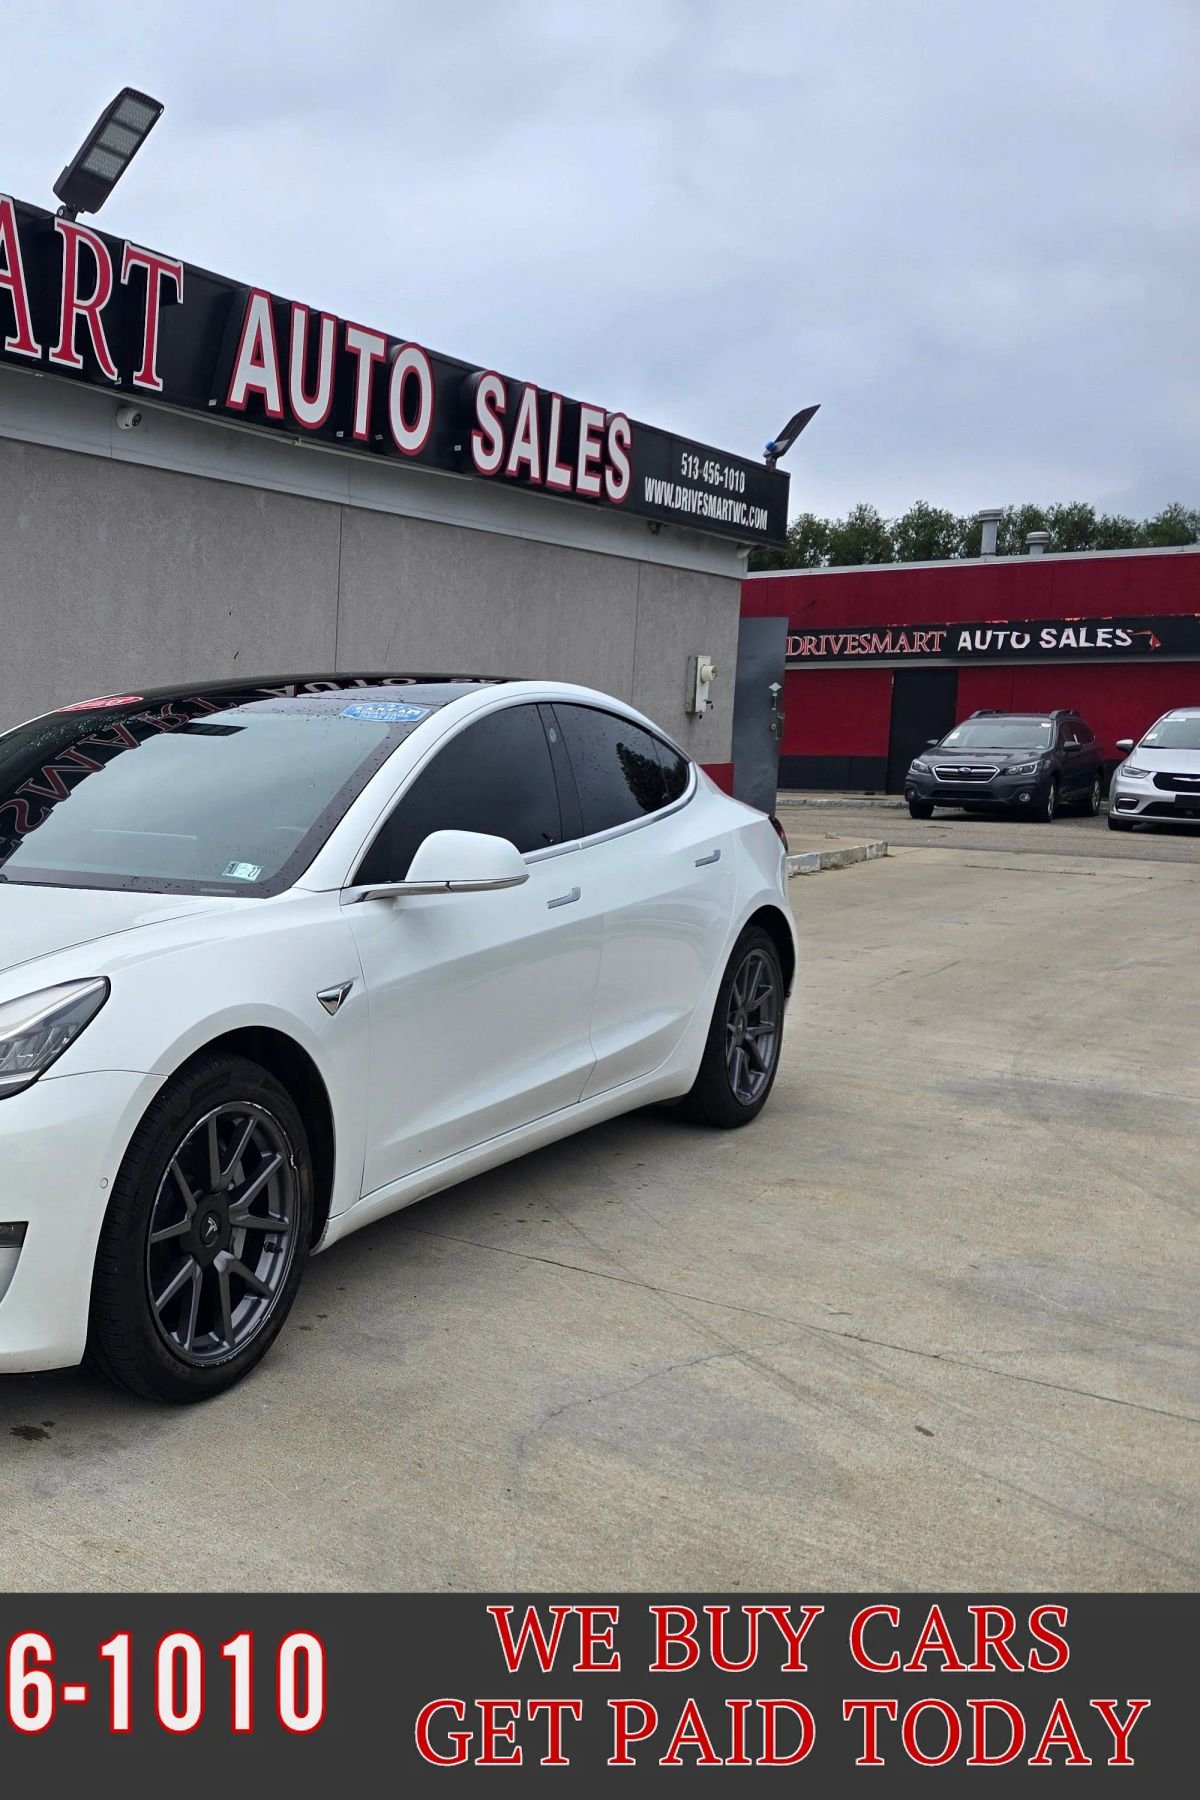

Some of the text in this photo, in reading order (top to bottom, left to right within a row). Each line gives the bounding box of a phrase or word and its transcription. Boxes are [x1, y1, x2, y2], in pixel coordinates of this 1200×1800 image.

[226, 287, 435, 456] AUTO
[471, 369, 632, 504] SALES
[785, 626, 1134, 656] DRIVESMART AUTO SALES
